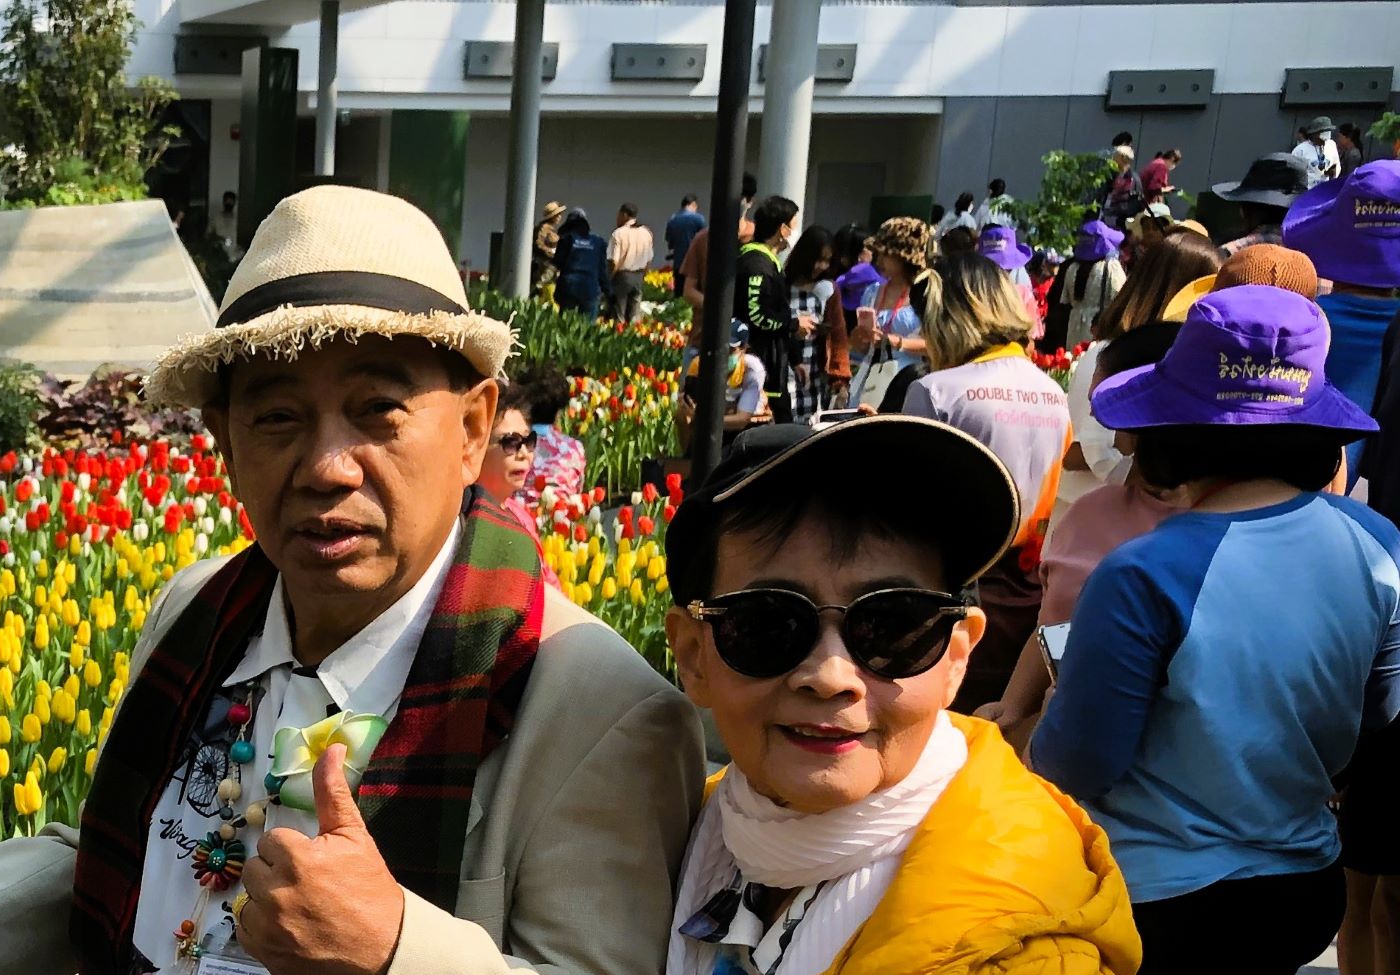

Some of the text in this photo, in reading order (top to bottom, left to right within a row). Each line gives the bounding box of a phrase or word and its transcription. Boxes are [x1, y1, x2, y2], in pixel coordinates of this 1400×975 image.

[748, 275, 783, 331] ACTIVATE
[966, 387, 1013, 401] DOUBLE
[1016, 389, 1038, 404] TWO
